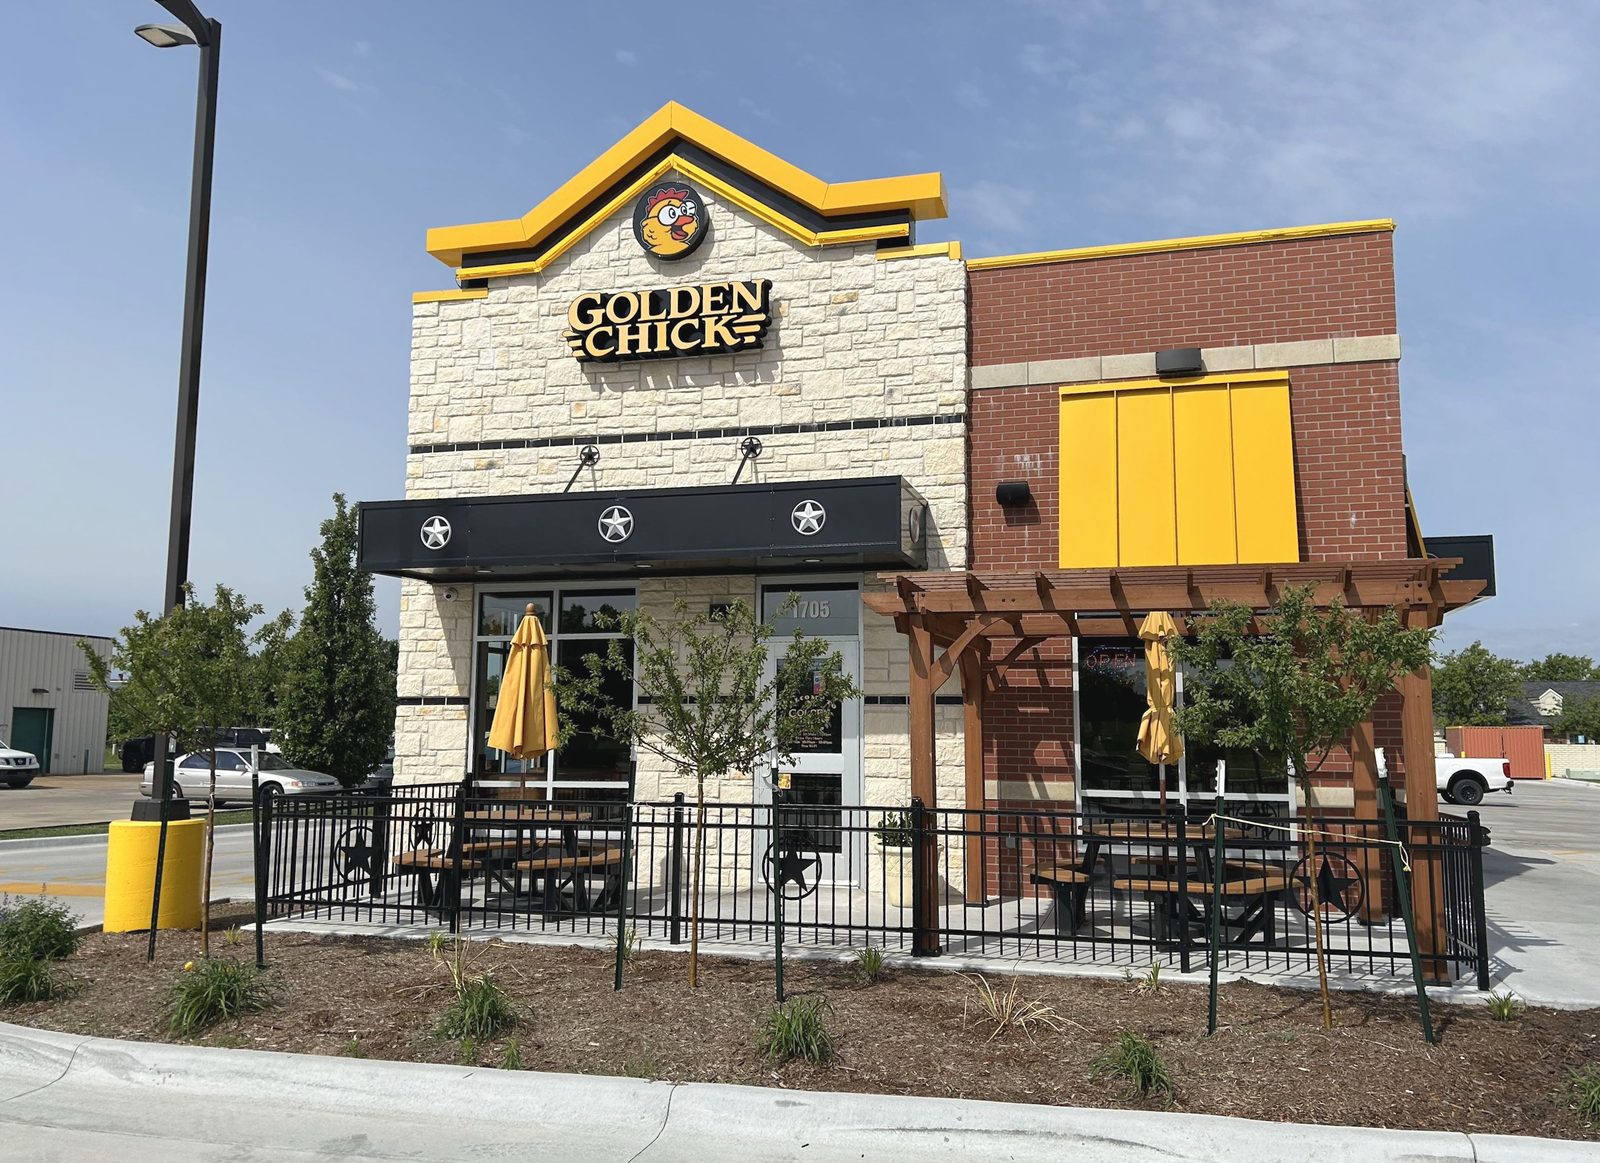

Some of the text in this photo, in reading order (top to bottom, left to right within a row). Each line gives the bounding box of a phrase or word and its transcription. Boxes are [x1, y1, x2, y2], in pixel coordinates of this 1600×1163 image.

[568, 279, 765, 331] GOLDEN
[585, 315, 741, 357] CHICK
[793, 601, 830, 618] 1705
[1086, 654, 1136, 668] OPEN
